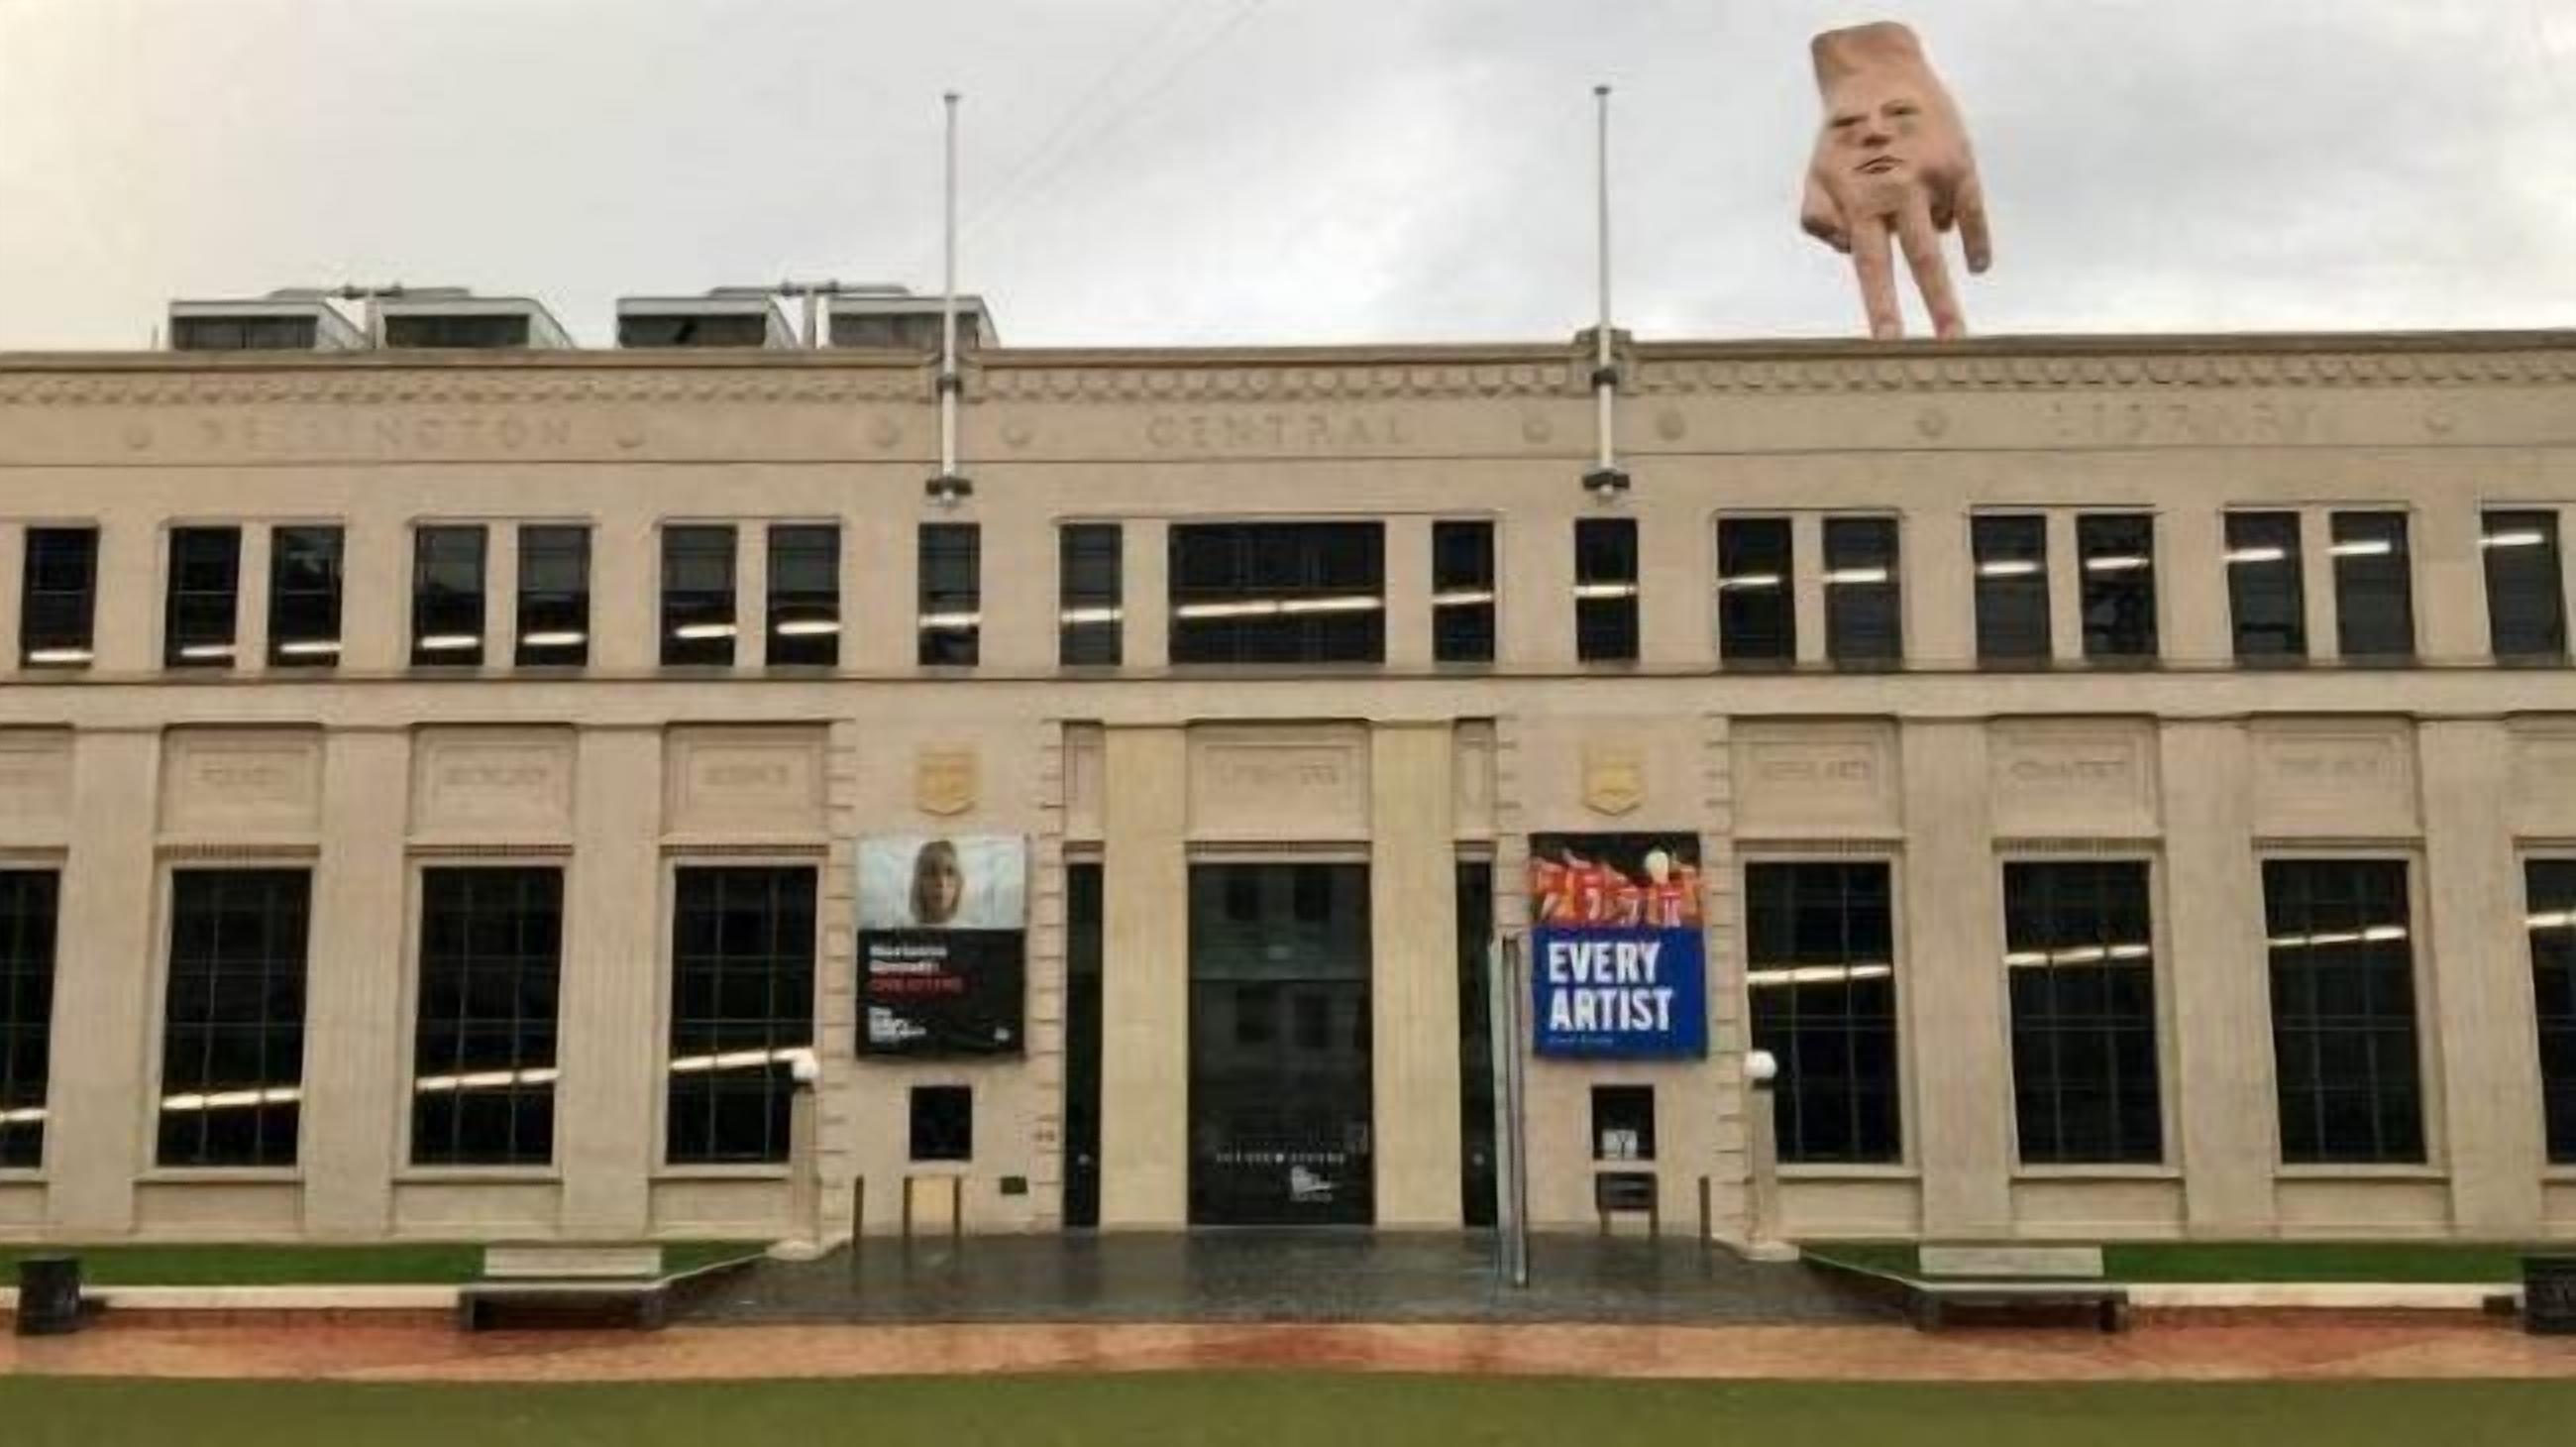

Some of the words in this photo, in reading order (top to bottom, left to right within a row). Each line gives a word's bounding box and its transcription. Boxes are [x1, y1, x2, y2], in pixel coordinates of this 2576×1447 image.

[1144, 412, 1416, 449] CENTRAL
[1548, 941, 1662, 983] EVERY
[1549, 987, 1674, 1032] ARTIST
